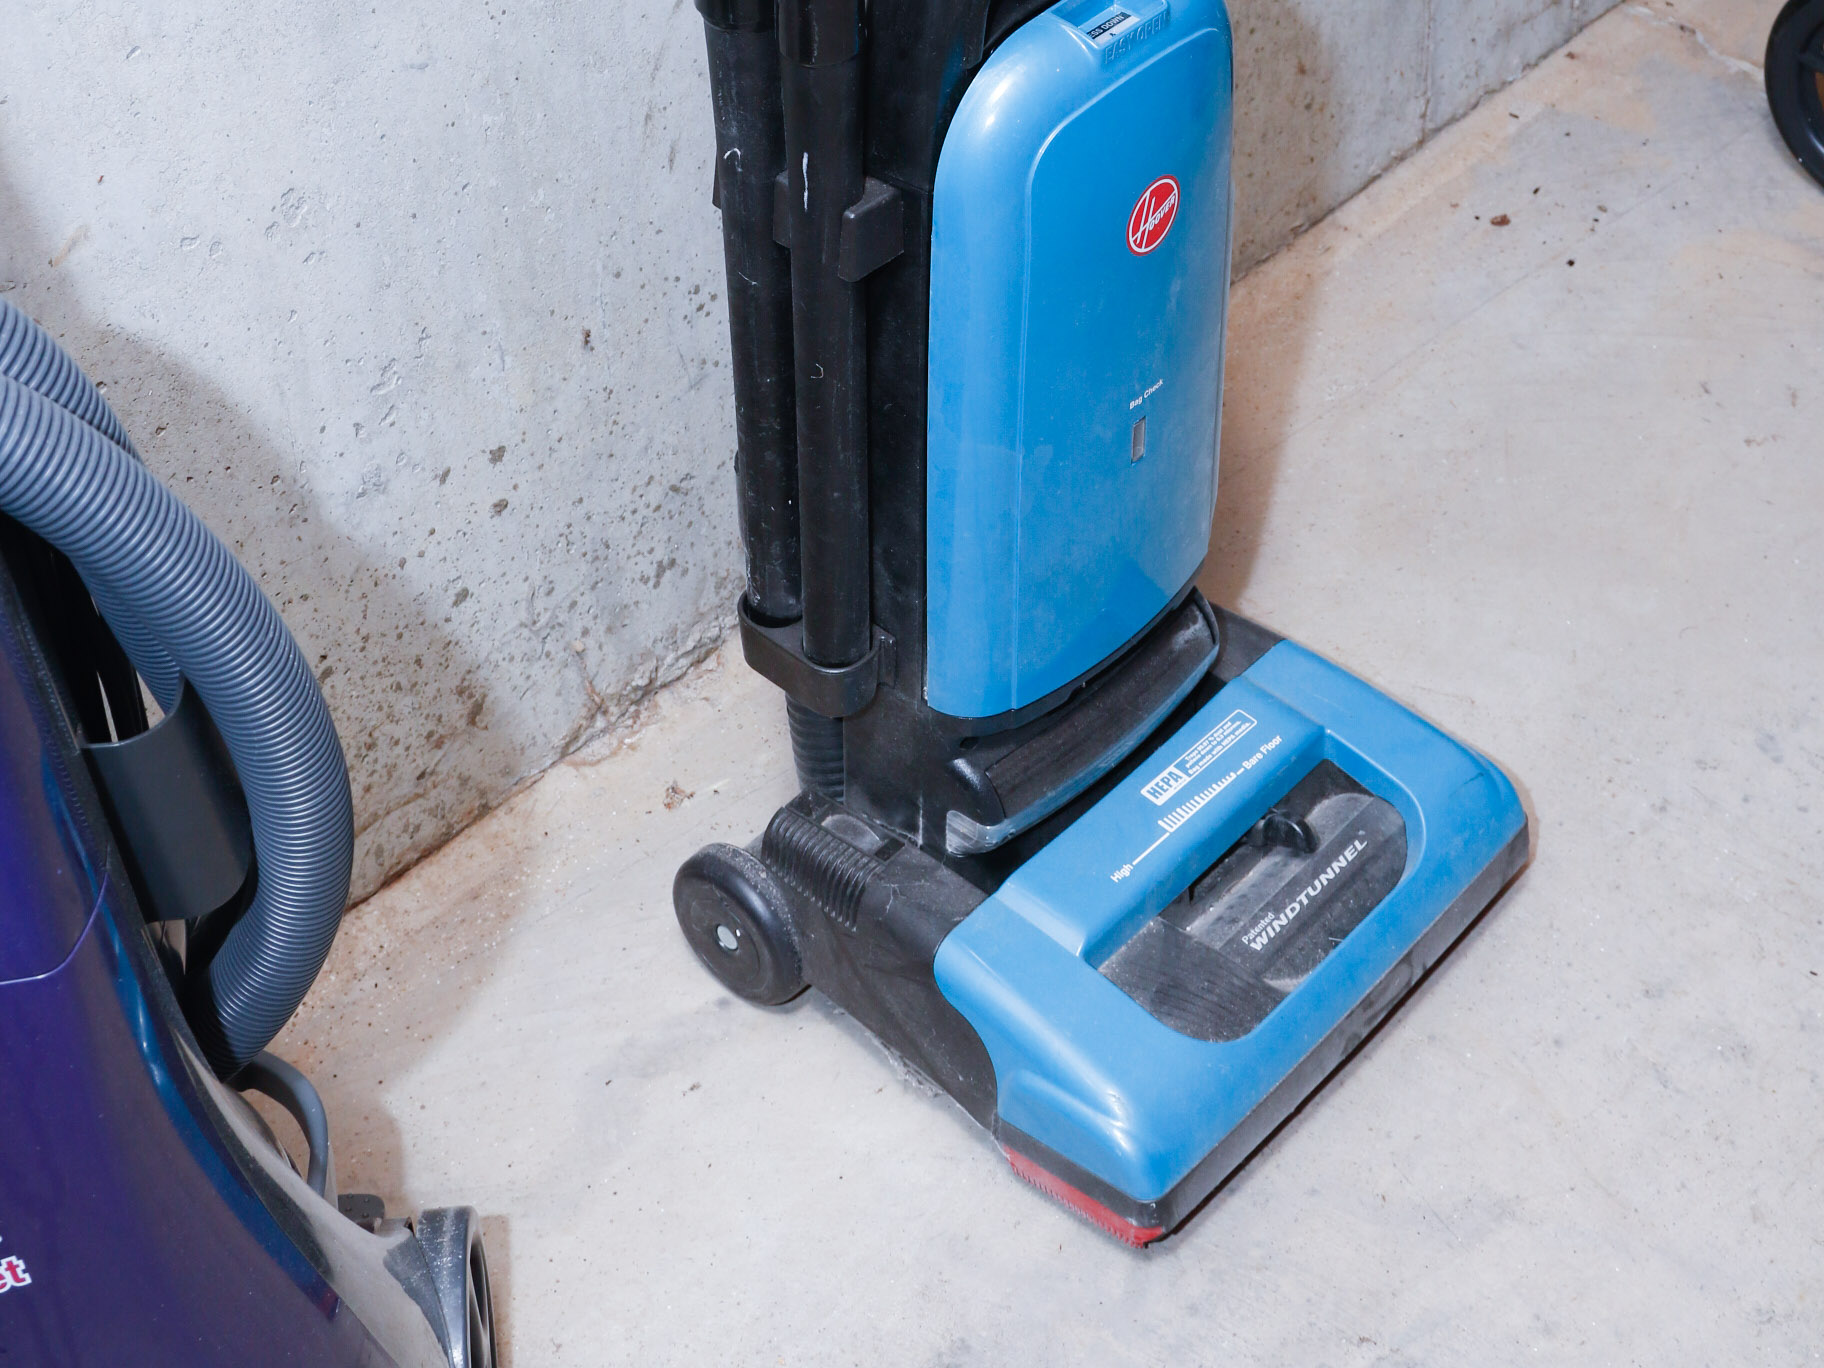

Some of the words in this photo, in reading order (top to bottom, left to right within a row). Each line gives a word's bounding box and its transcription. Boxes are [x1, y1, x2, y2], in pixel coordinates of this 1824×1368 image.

[1103, 15, 1125, 30] DOWN
[1105, 32, 1134, 64] EASY
[1137, 12, 1168, 40] OPEN
[1129, 395, 1143, 410] Bag
[1144, 379, 1163, 399] Check
[1188, 765, 1200, 775] Bag
[1198, 754, 1213, 766] made
[1212, 745, 1223, 755] with
[1221, 734, 1236, 746] HEPA
[1146, 771, 1184, 800] HEPA
[1110, 863, 1133, 883] High
[1241, 752, 1263, 770] Bare
[1260, 735, 1282, 755] Floor
[1249, 839, 1368, 951] WINDTUNNEL
[1241, 911, 1275, 945] Patented
